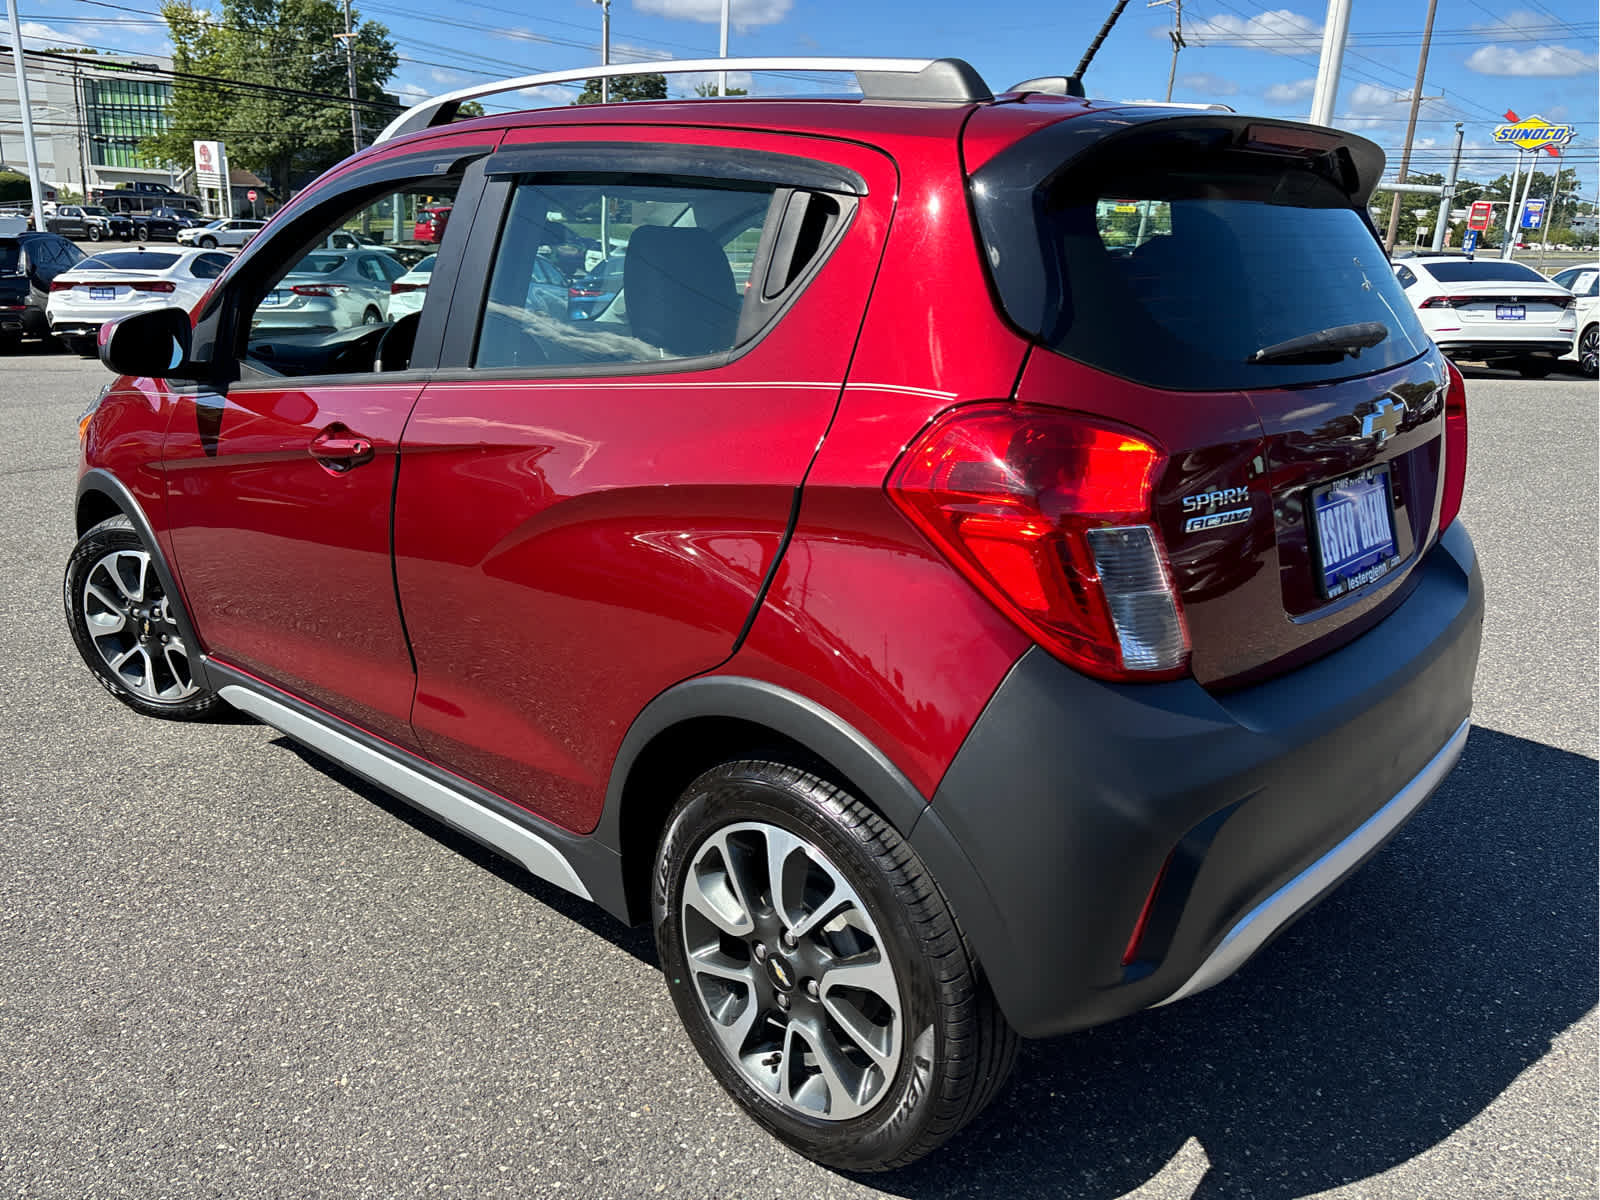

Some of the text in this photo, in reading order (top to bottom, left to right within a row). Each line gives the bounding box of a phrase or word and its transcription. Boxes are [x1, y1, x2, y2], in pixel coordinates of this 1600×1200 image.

[1499, 128, 1566, 140] SUNOCO
[1182, 485, 1249, 513] SPARK
[1187, 509, 1251, 531] ACTIV
